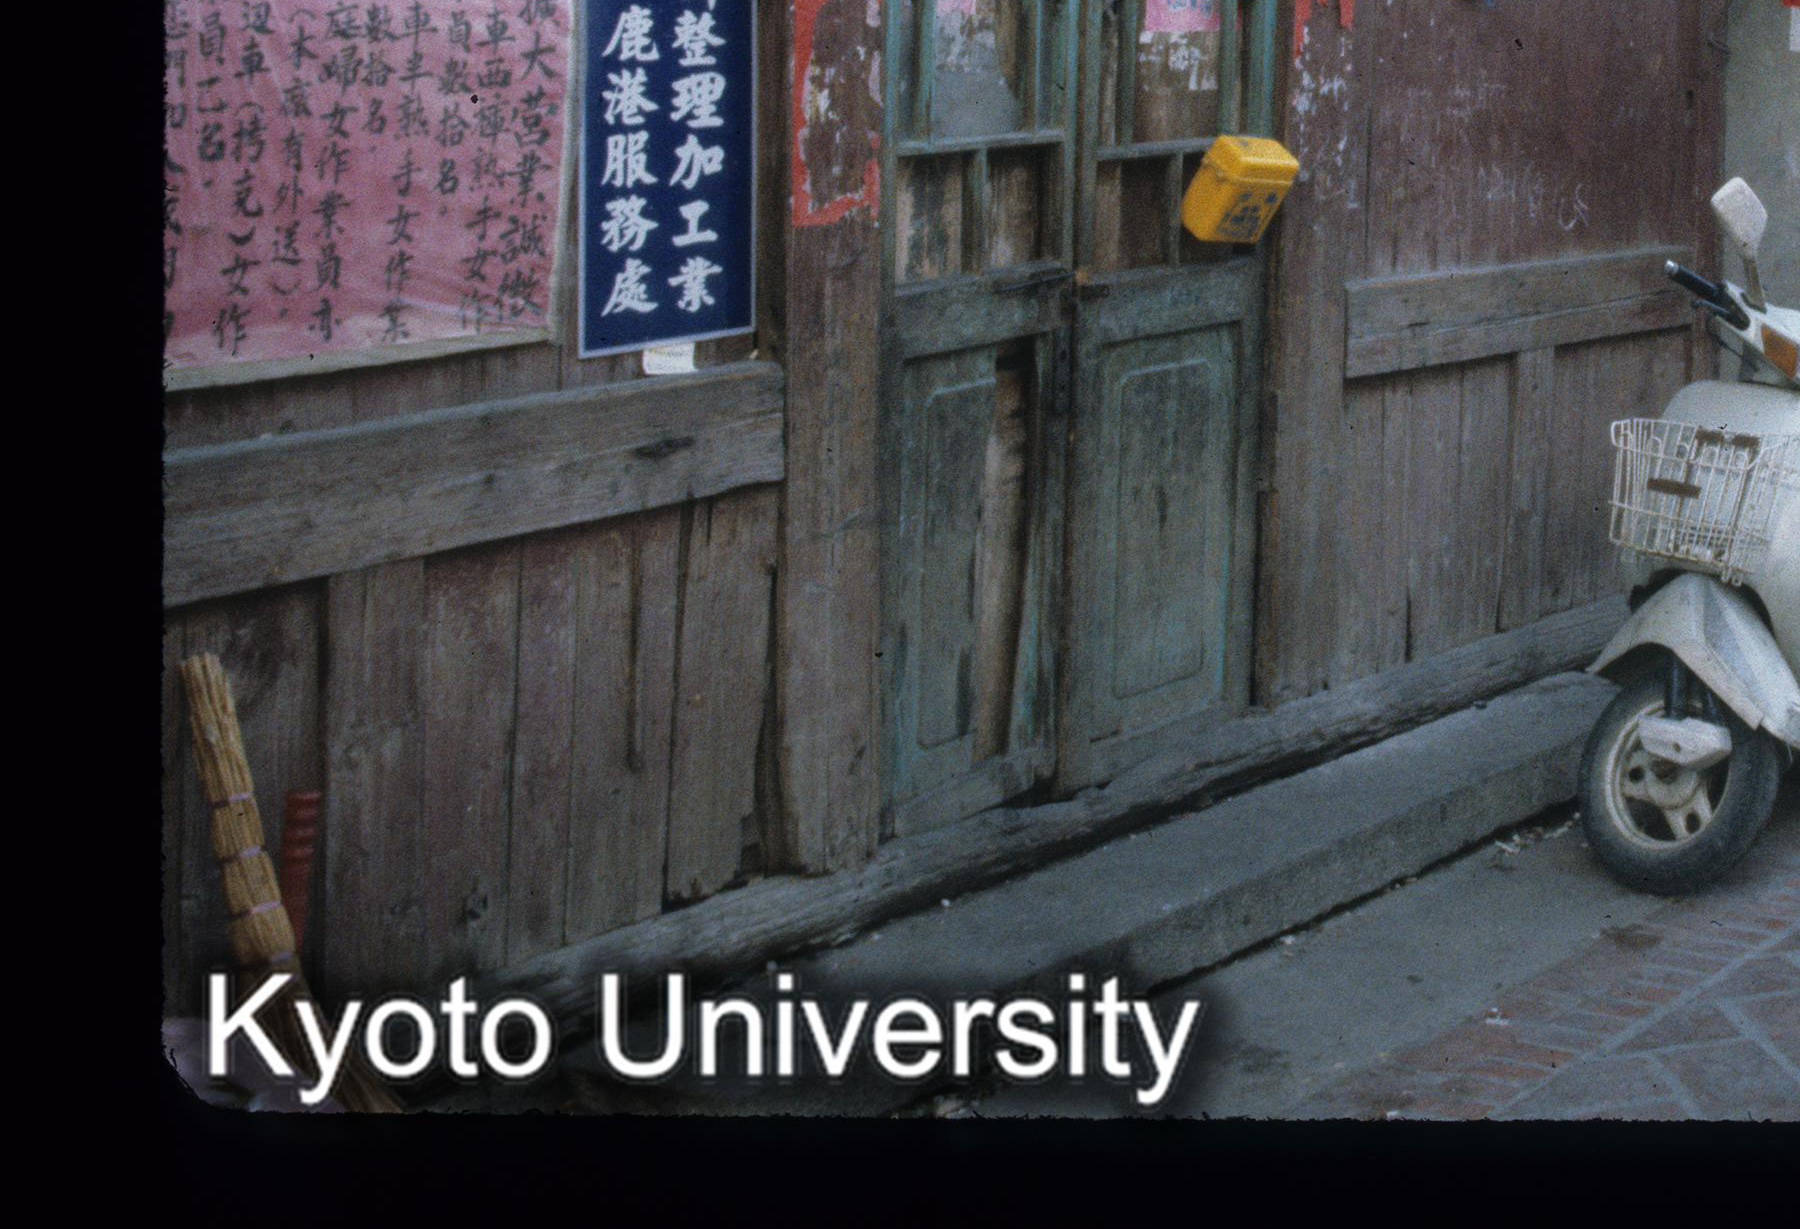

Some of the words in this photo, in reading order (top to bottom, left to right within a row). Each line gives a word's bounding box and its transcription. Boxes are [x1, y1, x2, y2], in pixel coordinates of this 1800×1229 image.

[600, 3, 660, 318] 鹿港服務處
